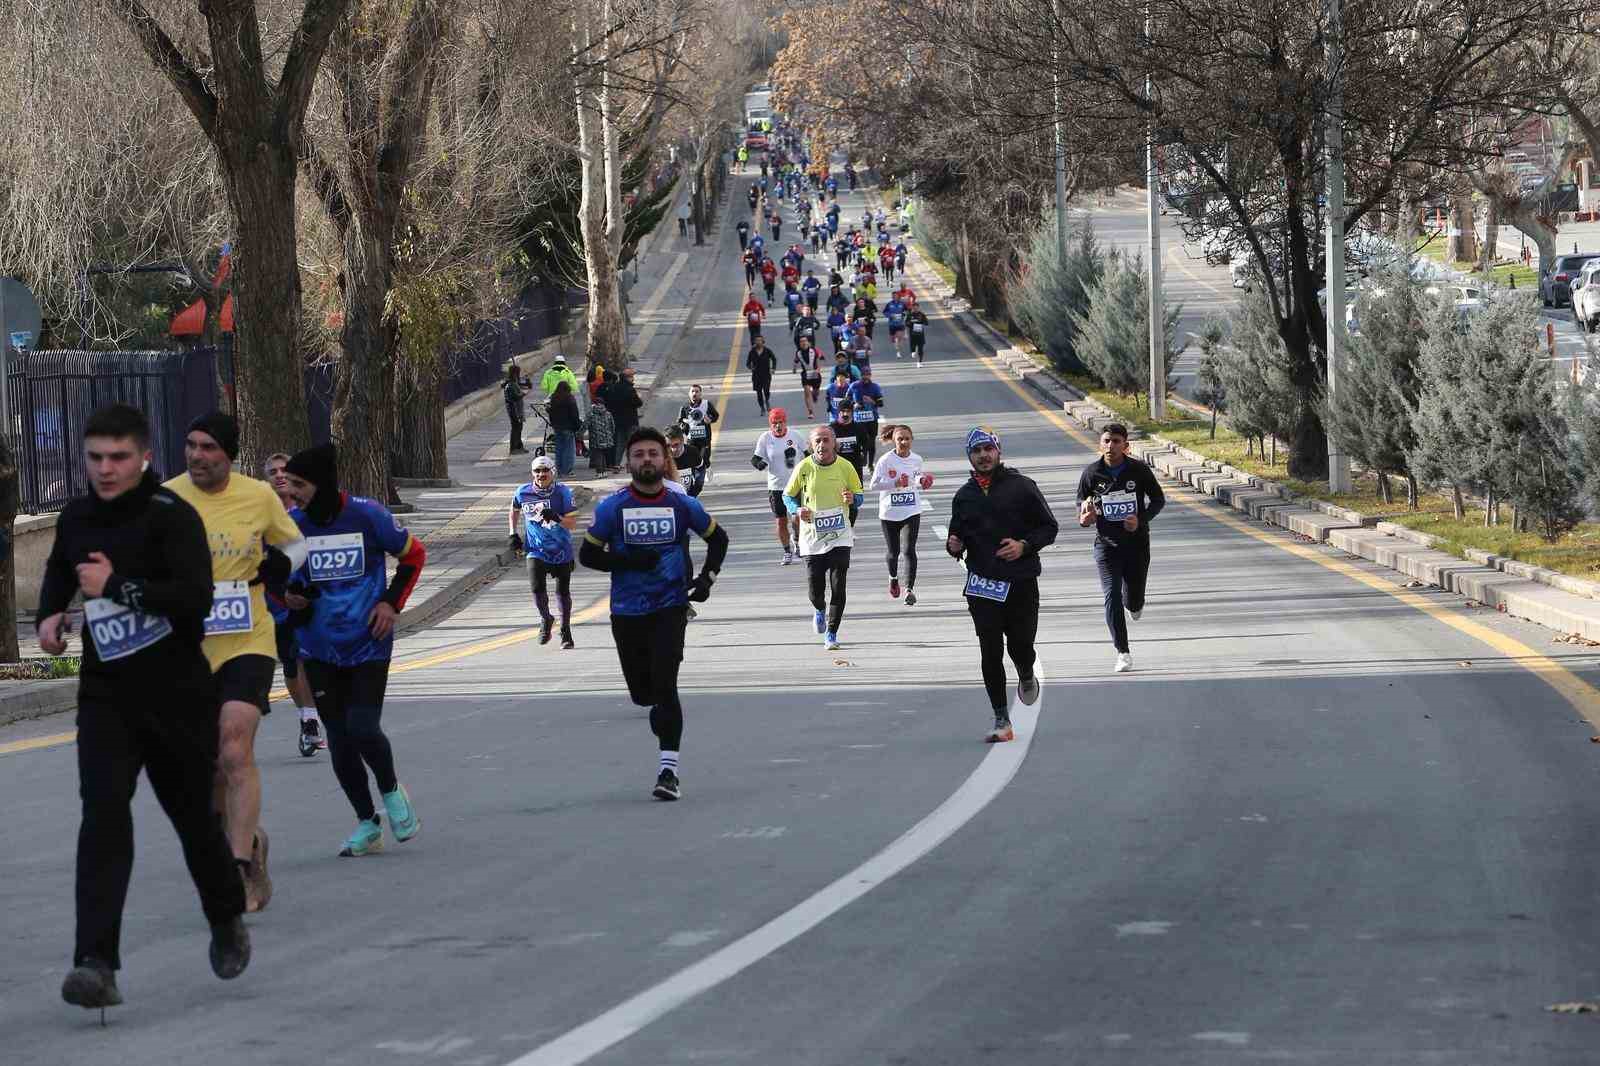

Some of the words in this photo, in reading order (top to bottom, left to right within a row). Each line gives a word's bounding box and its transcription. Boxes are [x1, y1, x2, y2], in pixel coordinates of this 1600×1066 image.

[892, 494, 914, 503] 0679
[1105, 503, 1135, 515] 0793
[628, 520, 671, 535] 0319
[817, 516, 842, 527] 0077
[311, 550, 359, 569] 0297
[970, 574, 1005, 592] 0453
